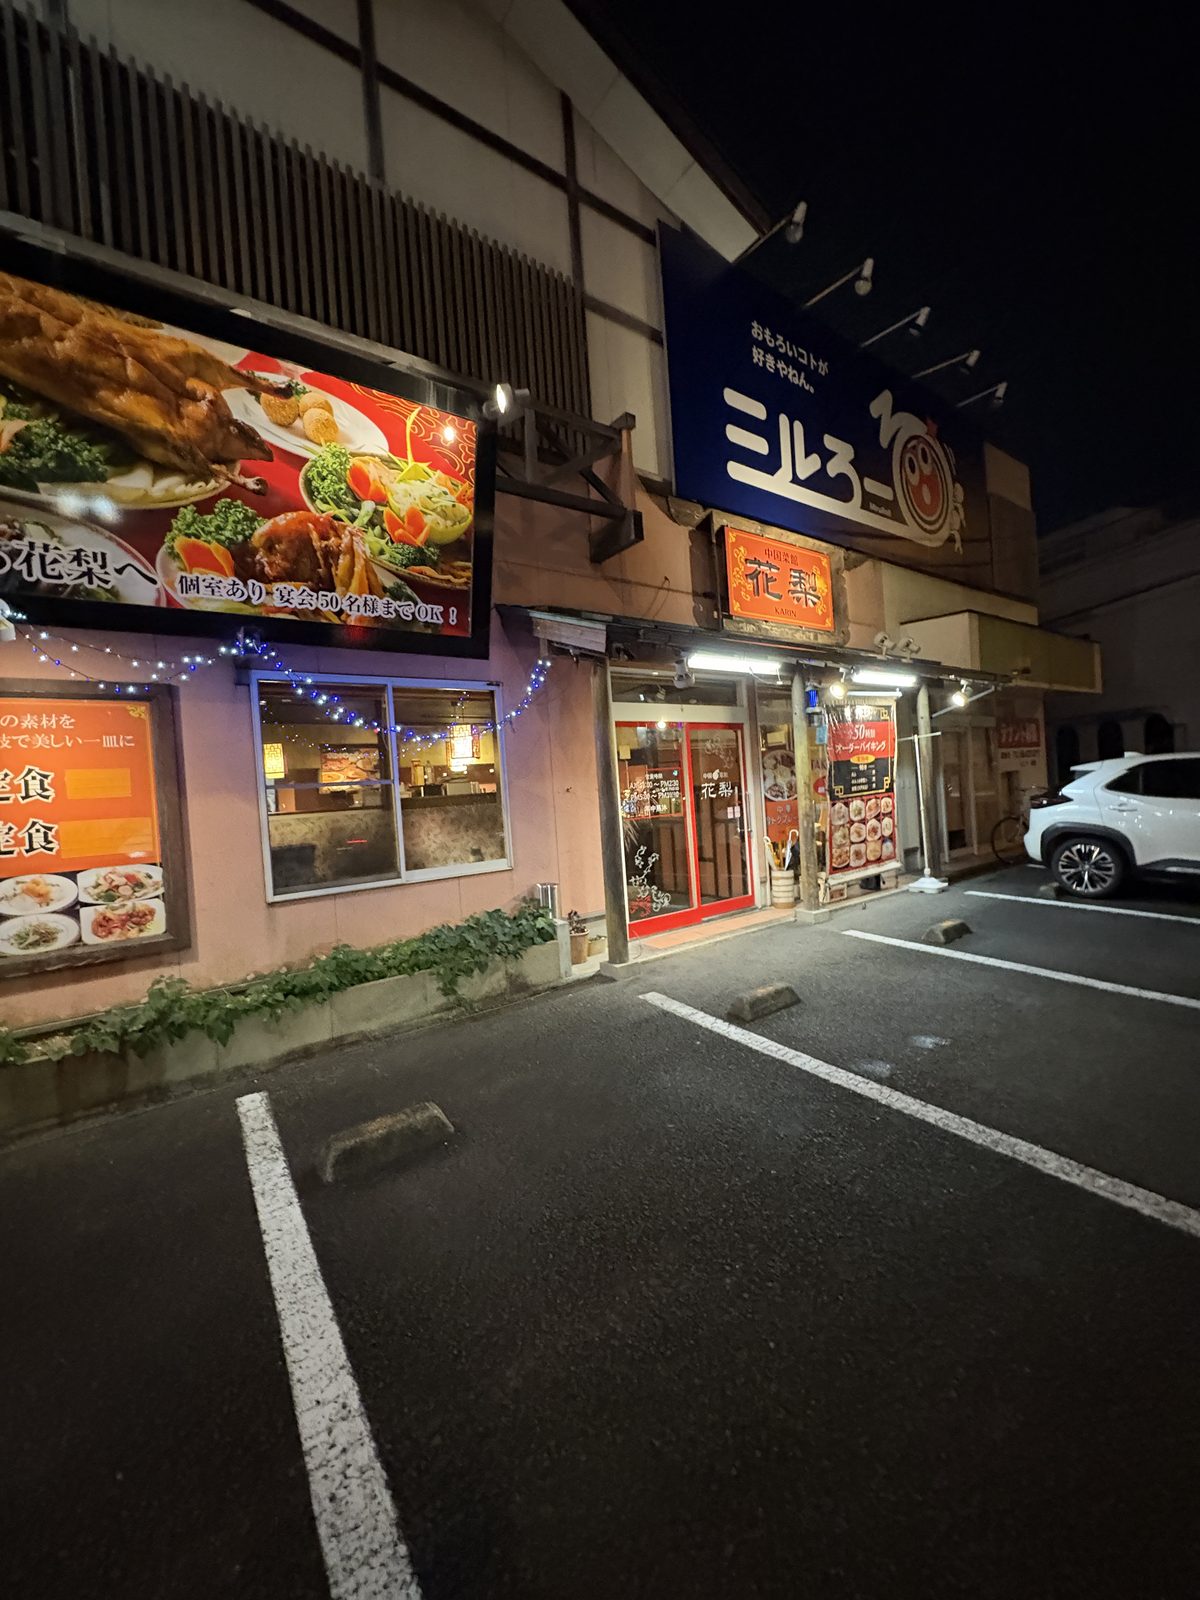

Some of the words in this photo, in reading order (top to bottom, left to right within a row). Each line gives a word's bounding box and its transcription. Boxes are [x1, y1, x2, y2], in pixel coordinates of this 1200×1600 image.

[751, 320, 829, 376] おもろいコトが
[752, 345, 815, 394] 好きやねん。
[0, 538, 159, 589] 花梨へ
[744, 557, 821, 607] 花梨
[178, 574, 265, 605] 個室あり
[774, 607, 797, 618] KARIN
[0, 713, 76, 729] の素材を
[701, 781, 734, 800] 花梨
